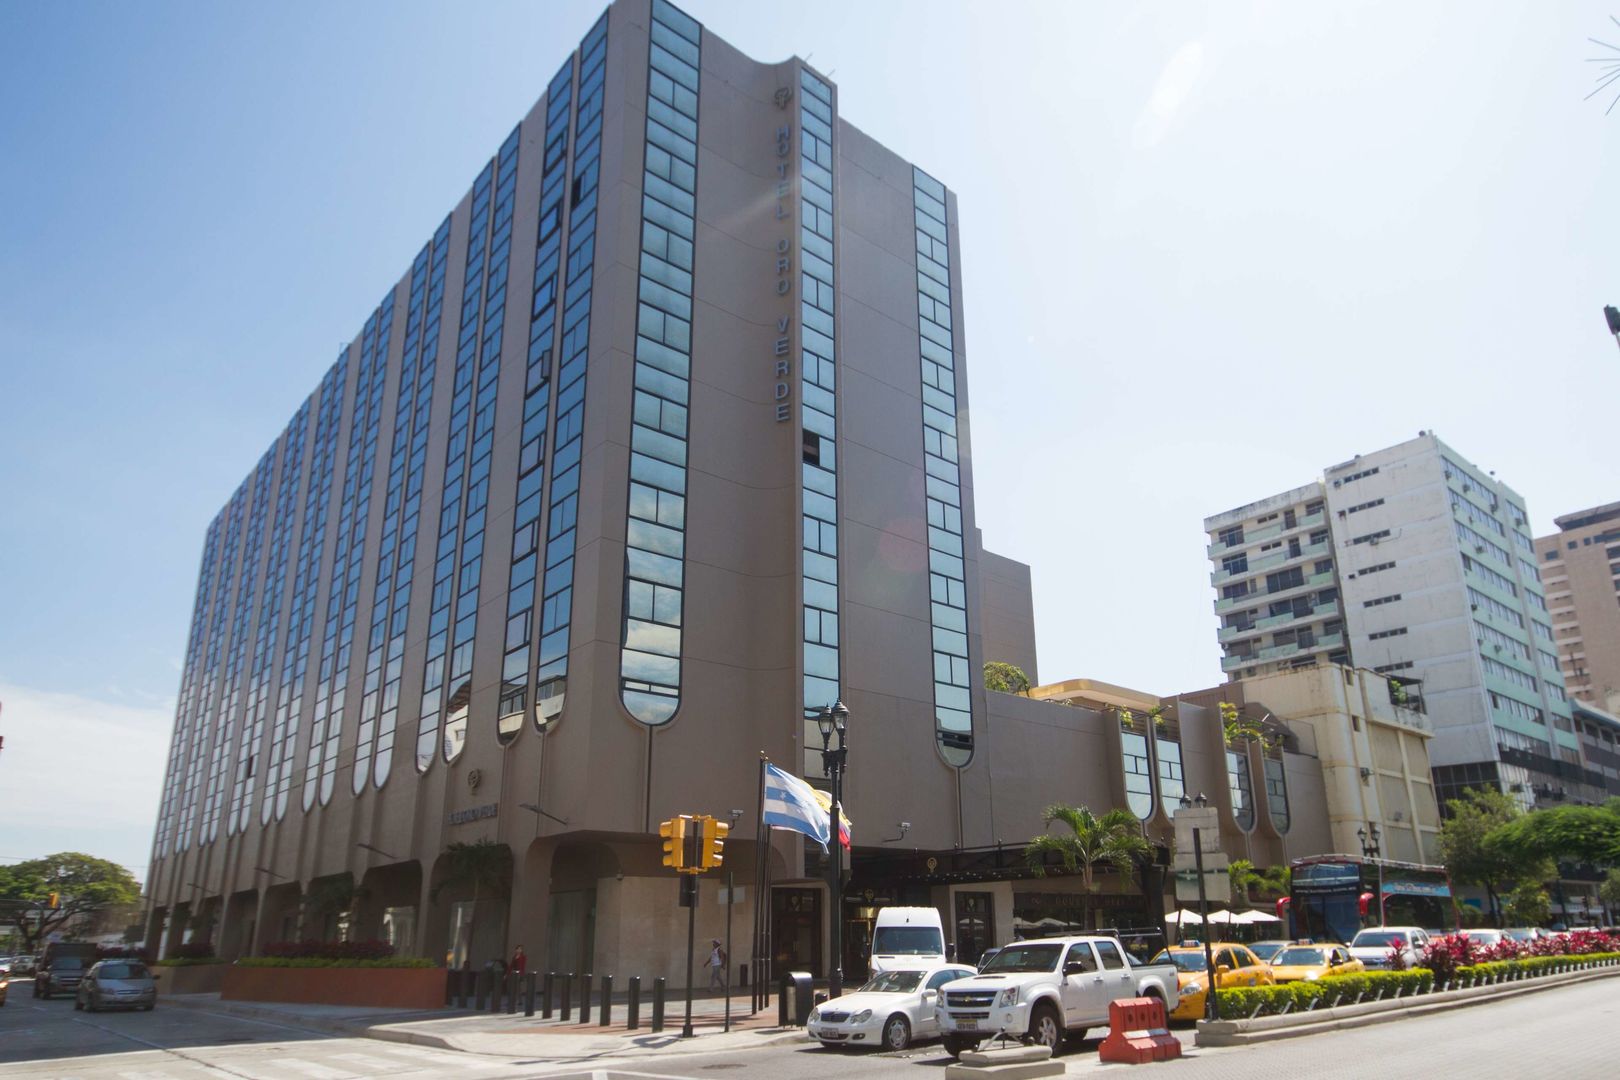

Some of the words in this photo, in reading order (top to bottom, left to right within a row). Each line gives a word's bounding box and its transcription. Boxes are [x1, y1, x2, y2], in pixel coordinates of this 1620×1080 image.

[776, 123, 790, 219] HOTEL
[775, 239, 790, 295] ORO
[775, 314, 791, 421] VERDE
